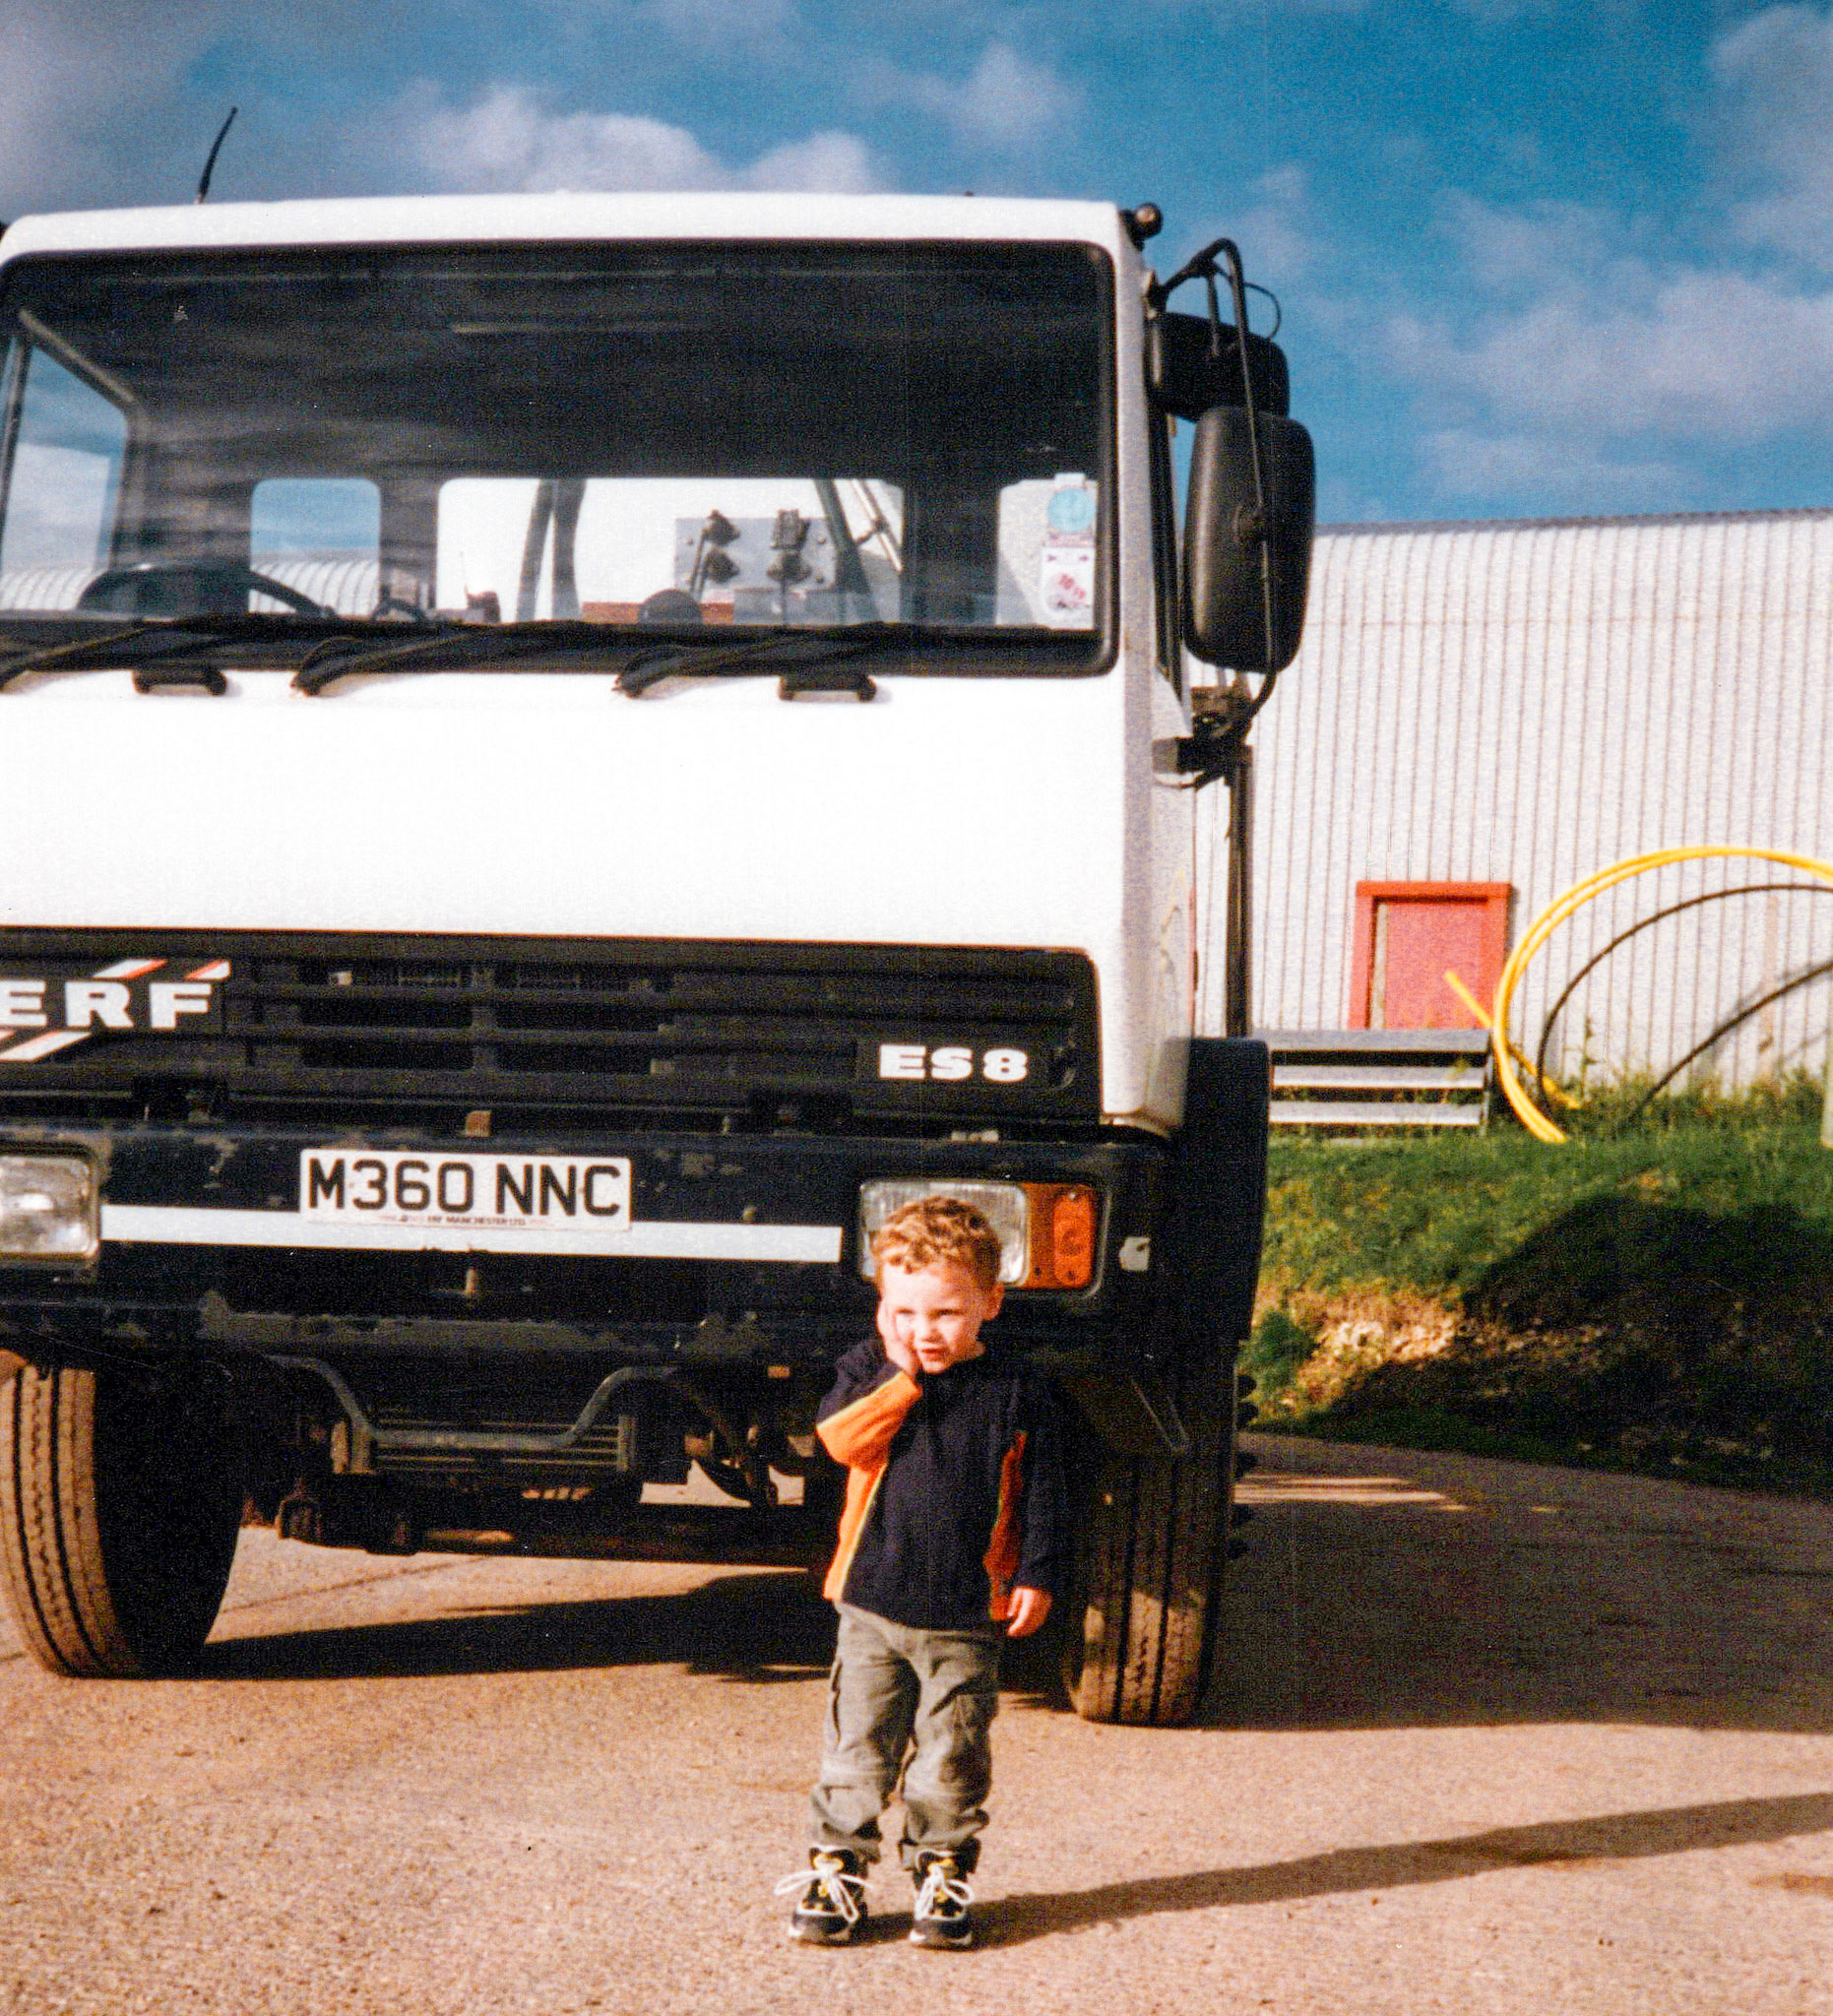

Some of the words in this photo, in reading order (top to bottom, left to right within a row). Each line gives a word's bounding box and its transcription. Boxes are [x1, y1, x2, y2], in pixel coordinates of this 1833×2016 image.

[0, 979, 213, 1030] ERF
[308, 1158, 474, 1214] M360
[495, 1163, 621, 1217] NNC
